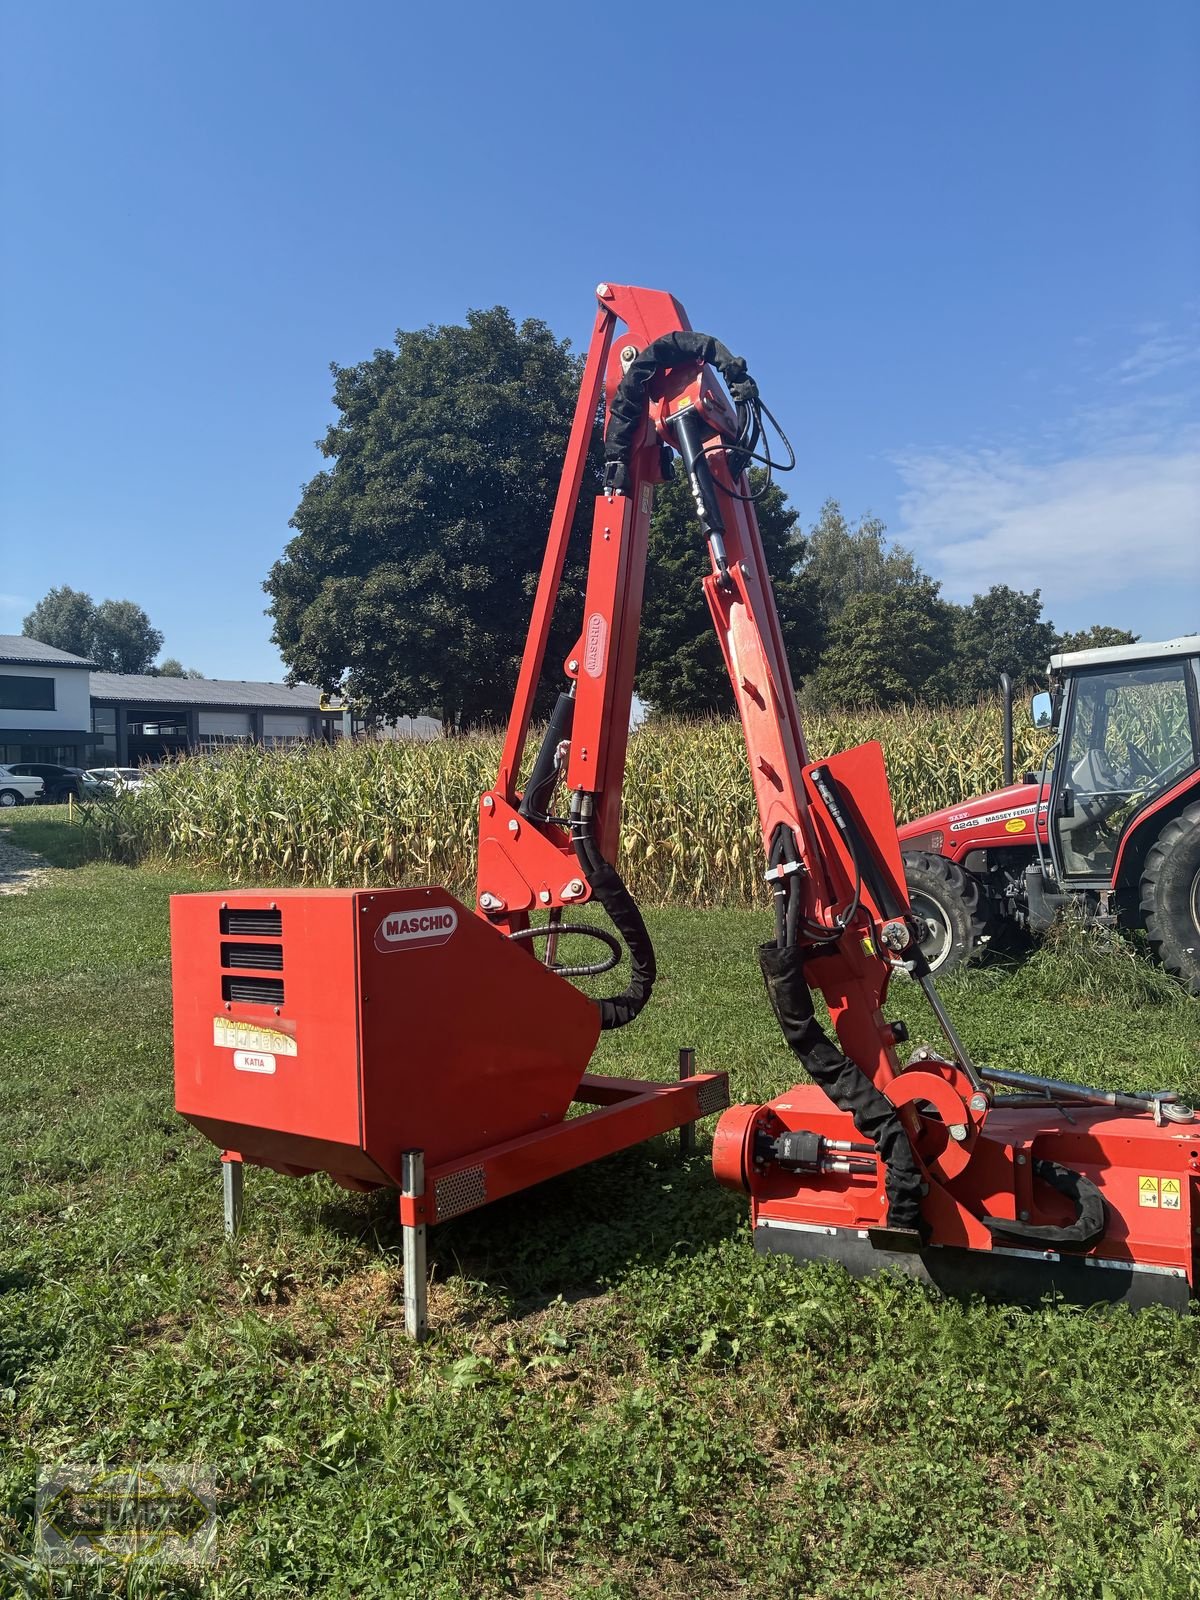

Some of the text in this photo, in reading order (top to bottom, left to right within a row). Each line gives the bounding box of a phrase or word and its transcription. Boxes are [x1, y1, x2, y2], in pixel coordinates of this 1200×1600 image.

[587, 618, 601, 670] MASCHIO
[952, 819, 979, 830] 4245
[985, 812, 1012, 823] MASSEY
[387, 914, 453, 936] MASCHIO
[244, 1056, 265, 1068] KATIA
